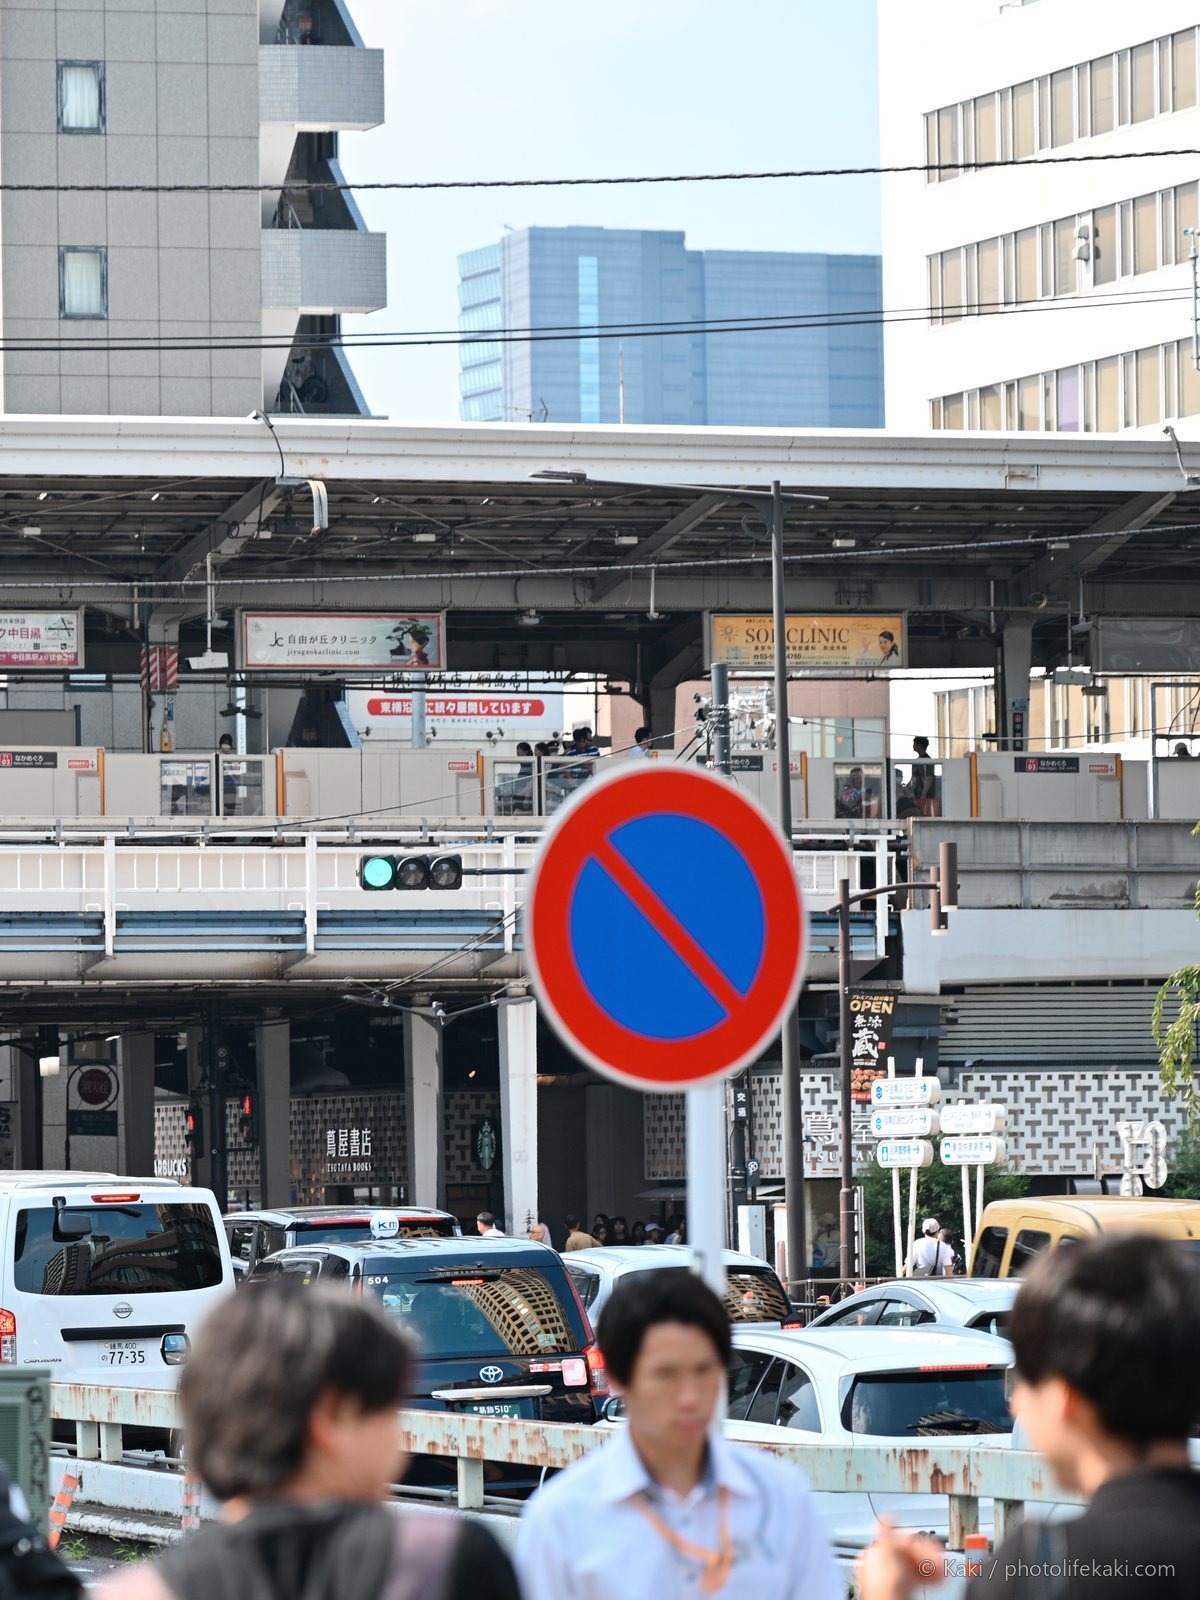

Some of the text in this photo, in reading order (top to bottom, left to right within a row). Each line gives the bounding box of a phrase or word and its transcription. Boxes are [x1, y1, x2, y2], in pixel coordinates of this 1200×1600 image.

[287, 634, 377, 645] 自由が丘クリニック
[786, 628, 850, 643] CLINIC
[286, 648, 360, 657] jiyugaokaclinic.com
[380, 701, 532, 714] 東横沿に続々展開しています
[849, 999, 894, 1015] OPEN
[736, 1092, 747, 1117] 交通
[326, 1127, 372, 1157] 蔦屋書店
[805, 1151, 877, 1162] TSUAY
[326, 1161, 372, 1173] TSUTAYA BOOKS
[367, 1276, 389, 1285] 504
[124, 1342, 137, 1350] 400
[109, 1350, 145, 1365] 77-35
[494, 1404, 509, 1414] 510
